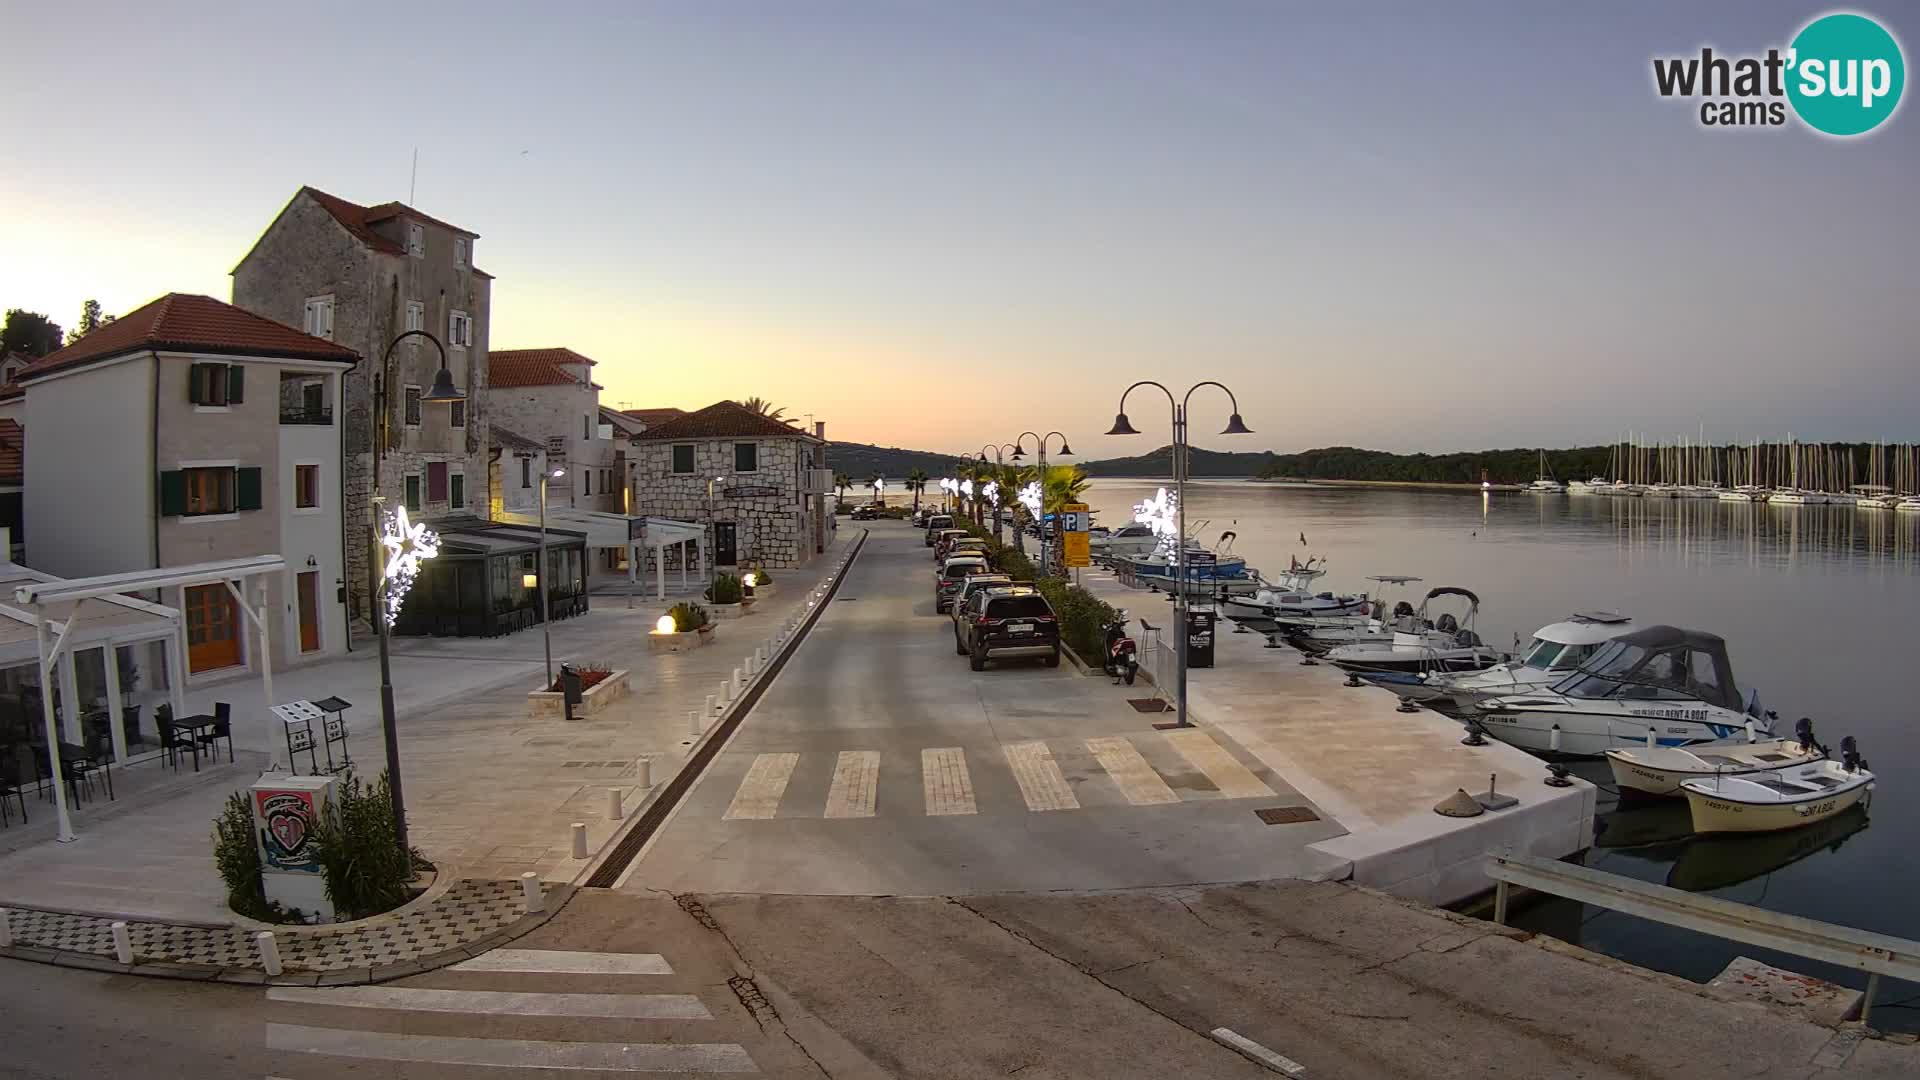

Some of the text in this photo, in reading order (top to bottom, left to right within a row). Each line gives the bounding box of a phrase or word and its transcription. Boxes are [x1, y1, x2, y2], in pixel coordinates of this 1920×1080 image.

[1066, 514, 1077, 530] P
[1665, 709, 1684, 719] RENT
[1684, 710, 1690, 719] A
[1691, 710, 1709, 721] BOAT
